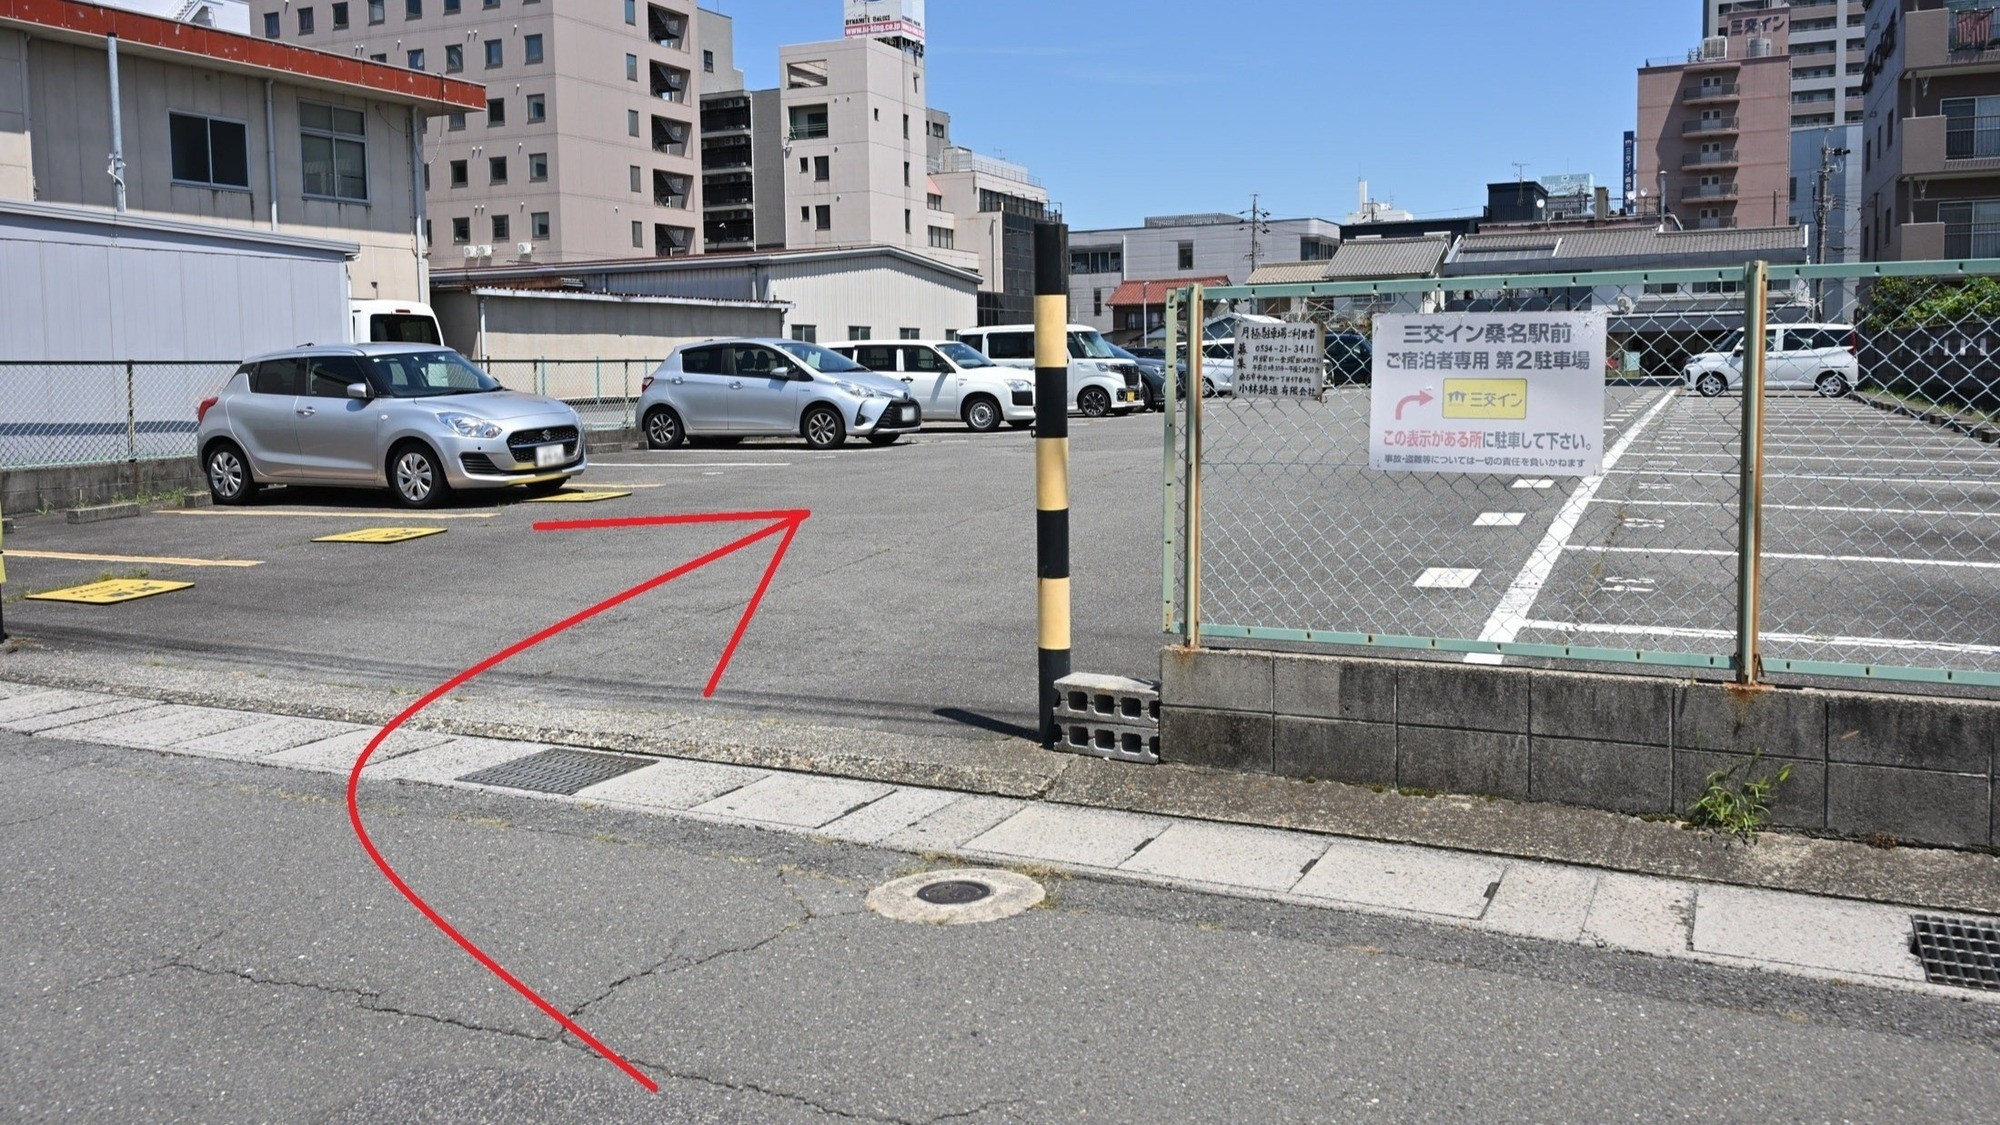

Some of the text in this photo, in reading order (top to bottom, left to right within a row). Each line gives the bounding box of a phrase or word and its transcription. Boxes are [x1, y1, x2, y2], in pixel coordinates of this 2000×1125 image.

[1731, 16, 1785, 36] 三交イン
[1403, 322, 1572, 344] 三交イン桑名駅前
[1255, 345, 1314, 354] 0594-21-3411
[1386, 350, 1590, 371] ご宿泊者専用 第2駐車場
[1470, 392, 1522, 407] 三交イン
[1383, 430, 1591, 451] この表示がある所に駐車して下さい。
